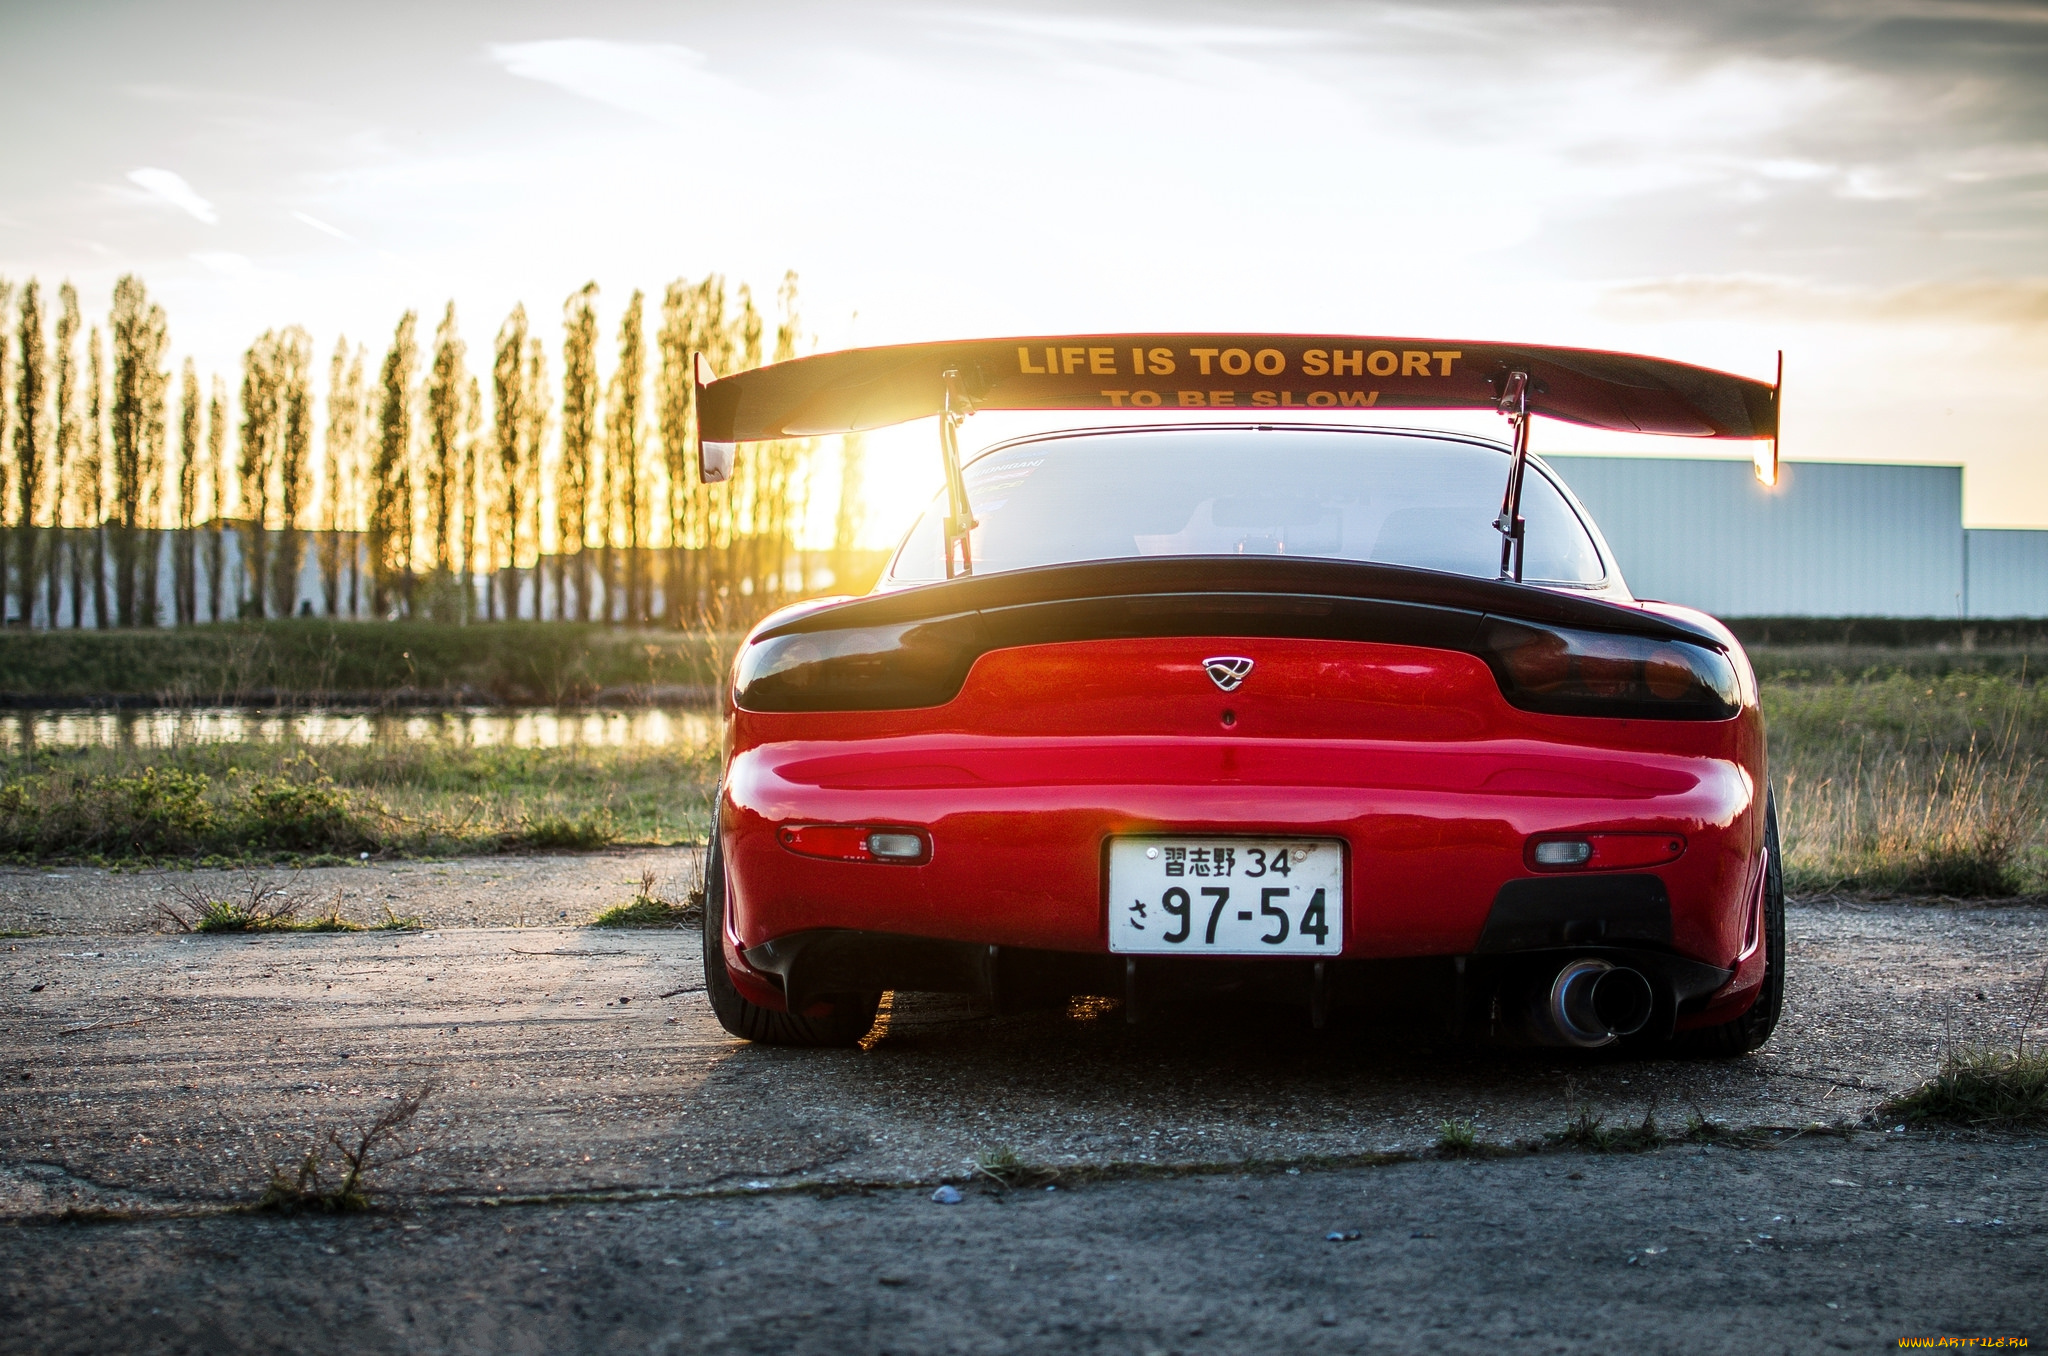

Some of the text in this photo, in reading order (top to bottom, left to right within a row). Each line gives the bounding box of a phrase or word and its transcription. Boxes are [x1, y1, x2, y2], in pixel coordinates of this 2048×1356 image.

[1017, 347, 1462, 377] LIFE IS TOO SHORT
[1101, 390, 1380, 408] TO BE SLOW
[1164, 847, 1291, 878] 習志野 34
[1129, 886, 1329, 946] さ 97-54
